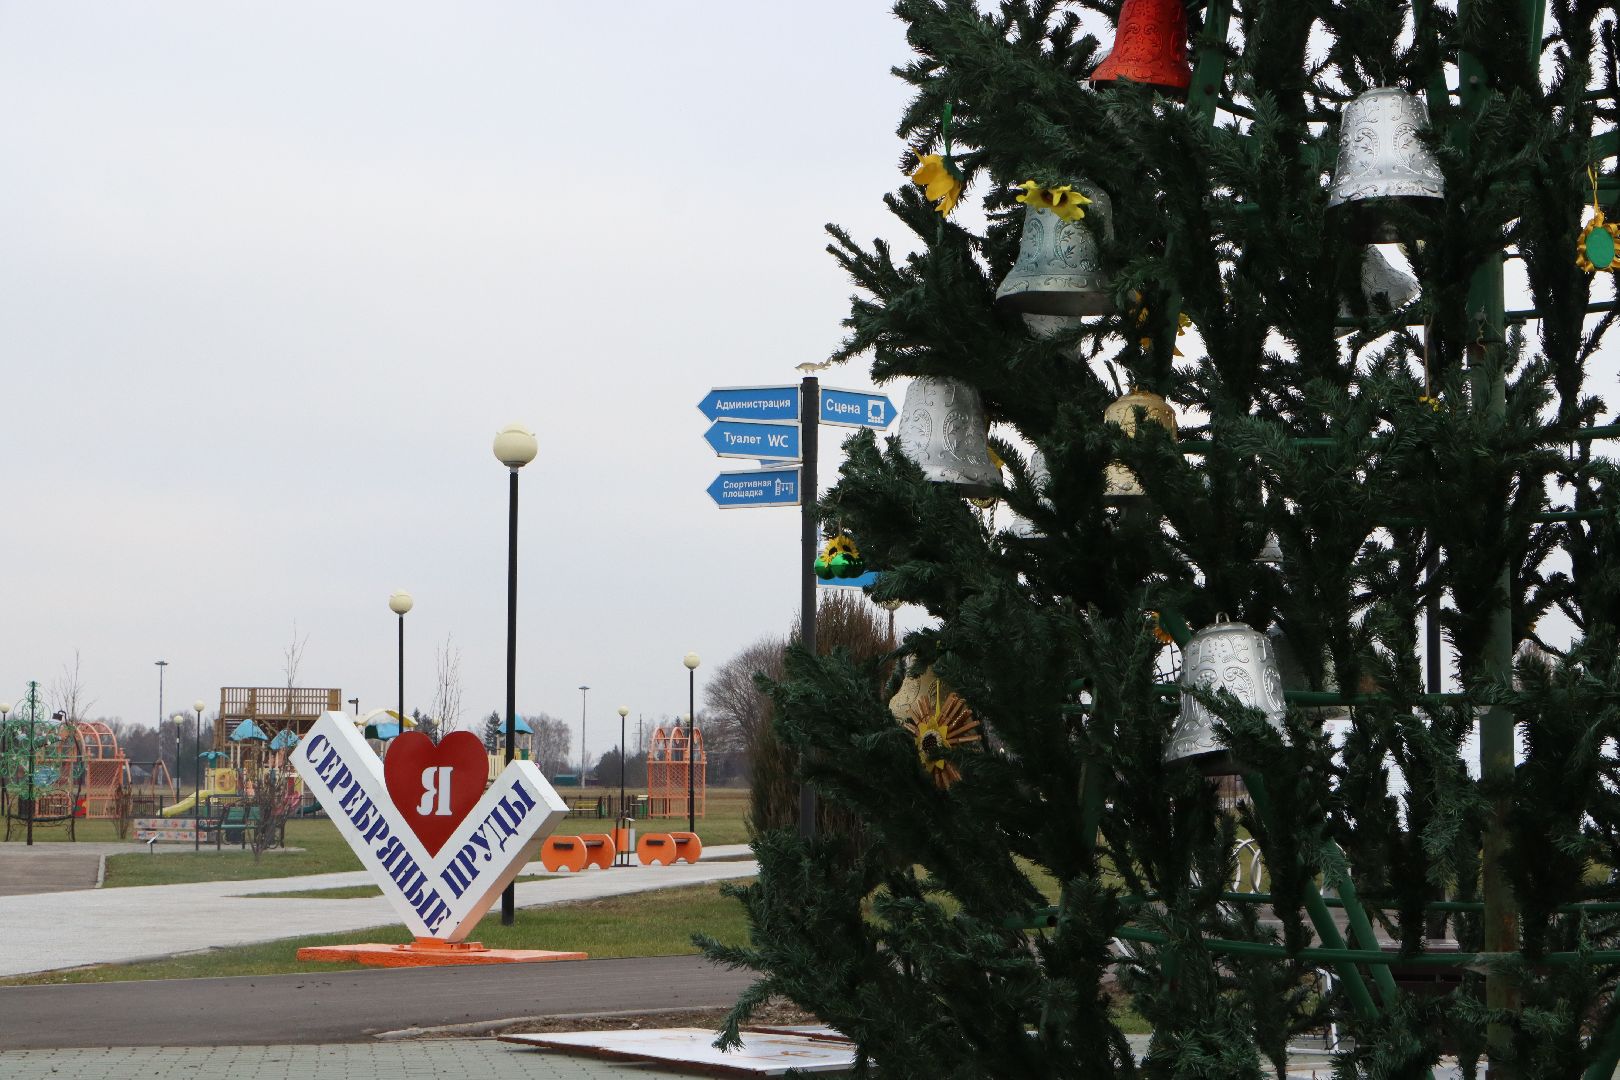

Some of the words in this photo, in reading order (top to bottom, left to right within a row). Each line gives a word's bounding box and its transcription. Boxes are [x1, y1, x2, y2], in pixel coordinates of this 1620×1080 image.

[715, 399, 791, 411] Администрация
[826, 398, 861, 415] Сцена
[723, 432, 762, 445] Туалет
[768, 434, 789, 448] WC
[723, 479, 772, 490] Спортивная
[722, 489, 764, 498] площадка
[416, 766, 454, 816] Я
[305, 734, 452, 936] СЕРЕБРЯНЫЕ
[439, 779, 537, 899] ПРУДЫ
